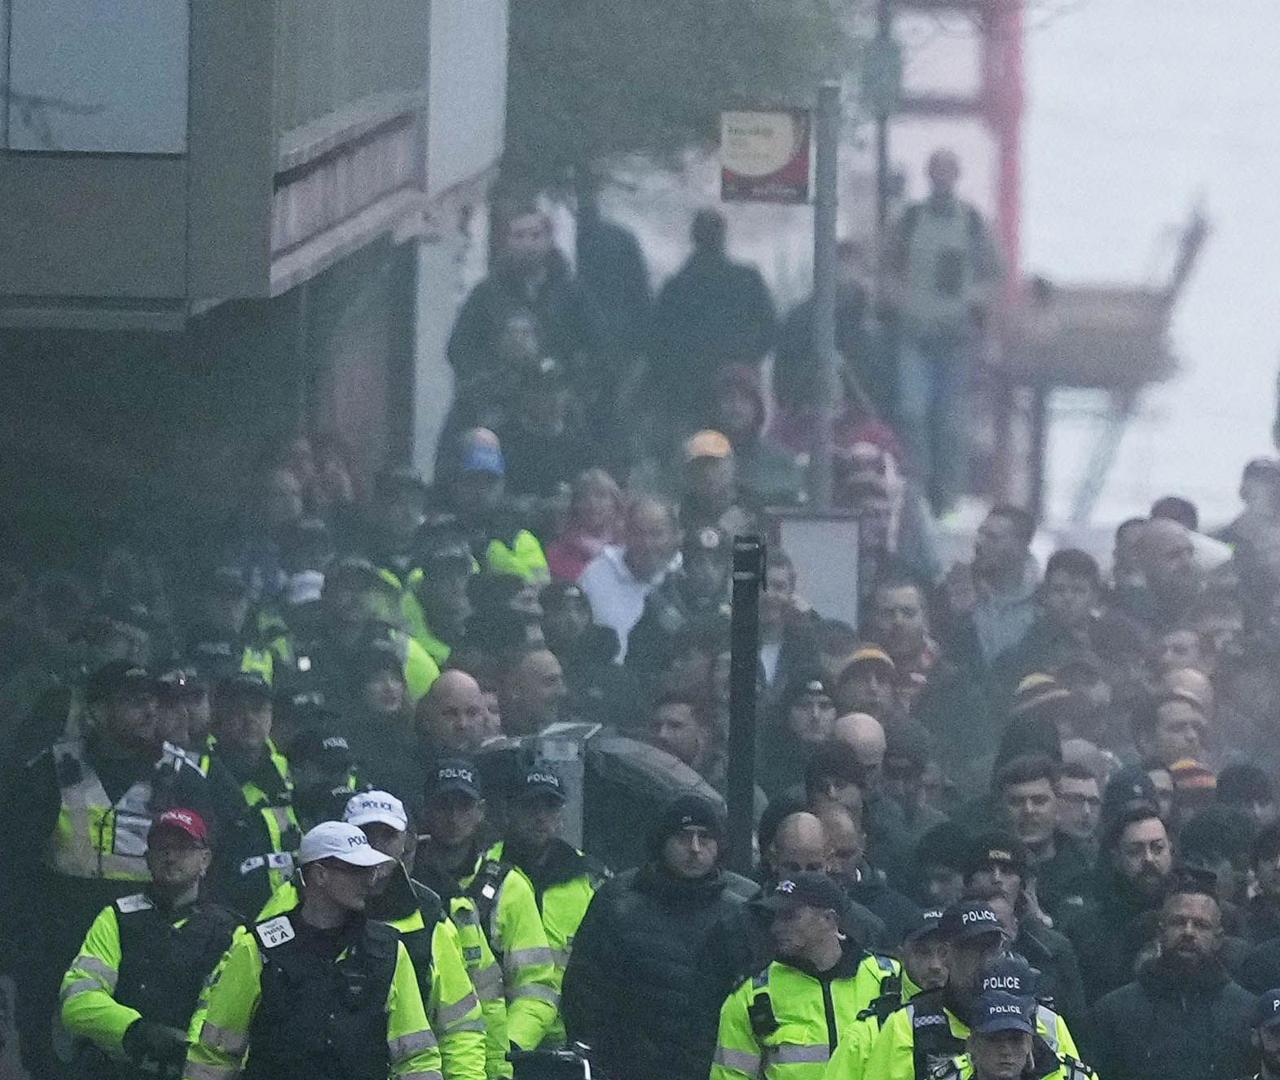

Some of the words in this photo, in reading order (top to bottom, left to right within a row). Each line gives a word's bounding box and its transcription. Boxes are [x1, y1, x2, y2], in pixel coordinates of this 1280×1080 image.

[438, 768, 473, 783] POLICE
[527, 771, 559, 787] POLICE
[962, 910, 998, 925] POLICE
[983, 976, 1021, 990] POLICE
[989, 1005, 1022, 1015] POLICE
